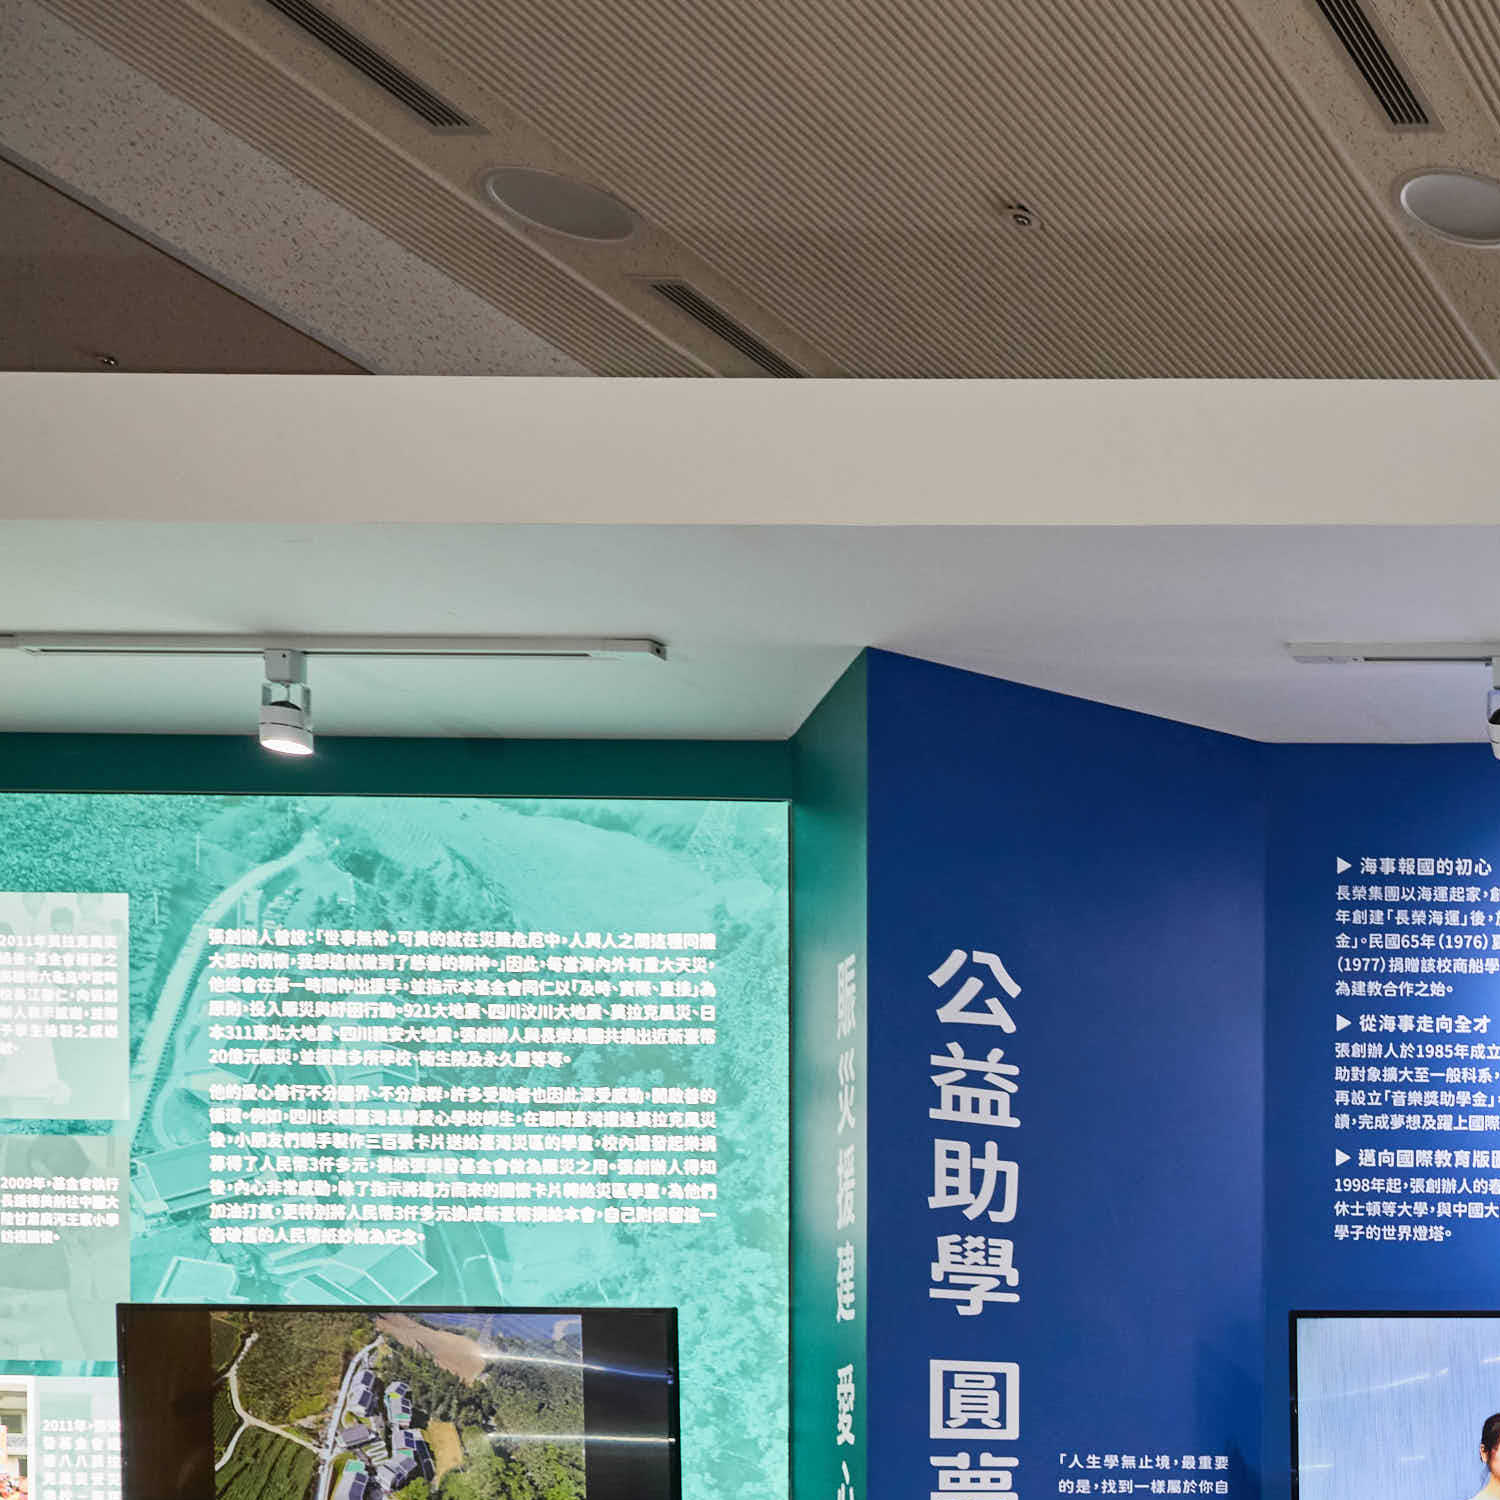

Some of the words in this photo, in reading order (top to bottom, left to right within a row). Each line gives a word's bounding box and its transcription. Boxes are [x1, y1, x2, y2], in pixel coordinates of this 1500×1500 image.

[1360, 857, 1492, 876] 海事報國的初心
[1336, 980, 1454, 997] 為建教合作之始。
[1359, 1014, 1491, 1033] 從海事走向全才
[927, 947, 1021, 1317] 公益助學
